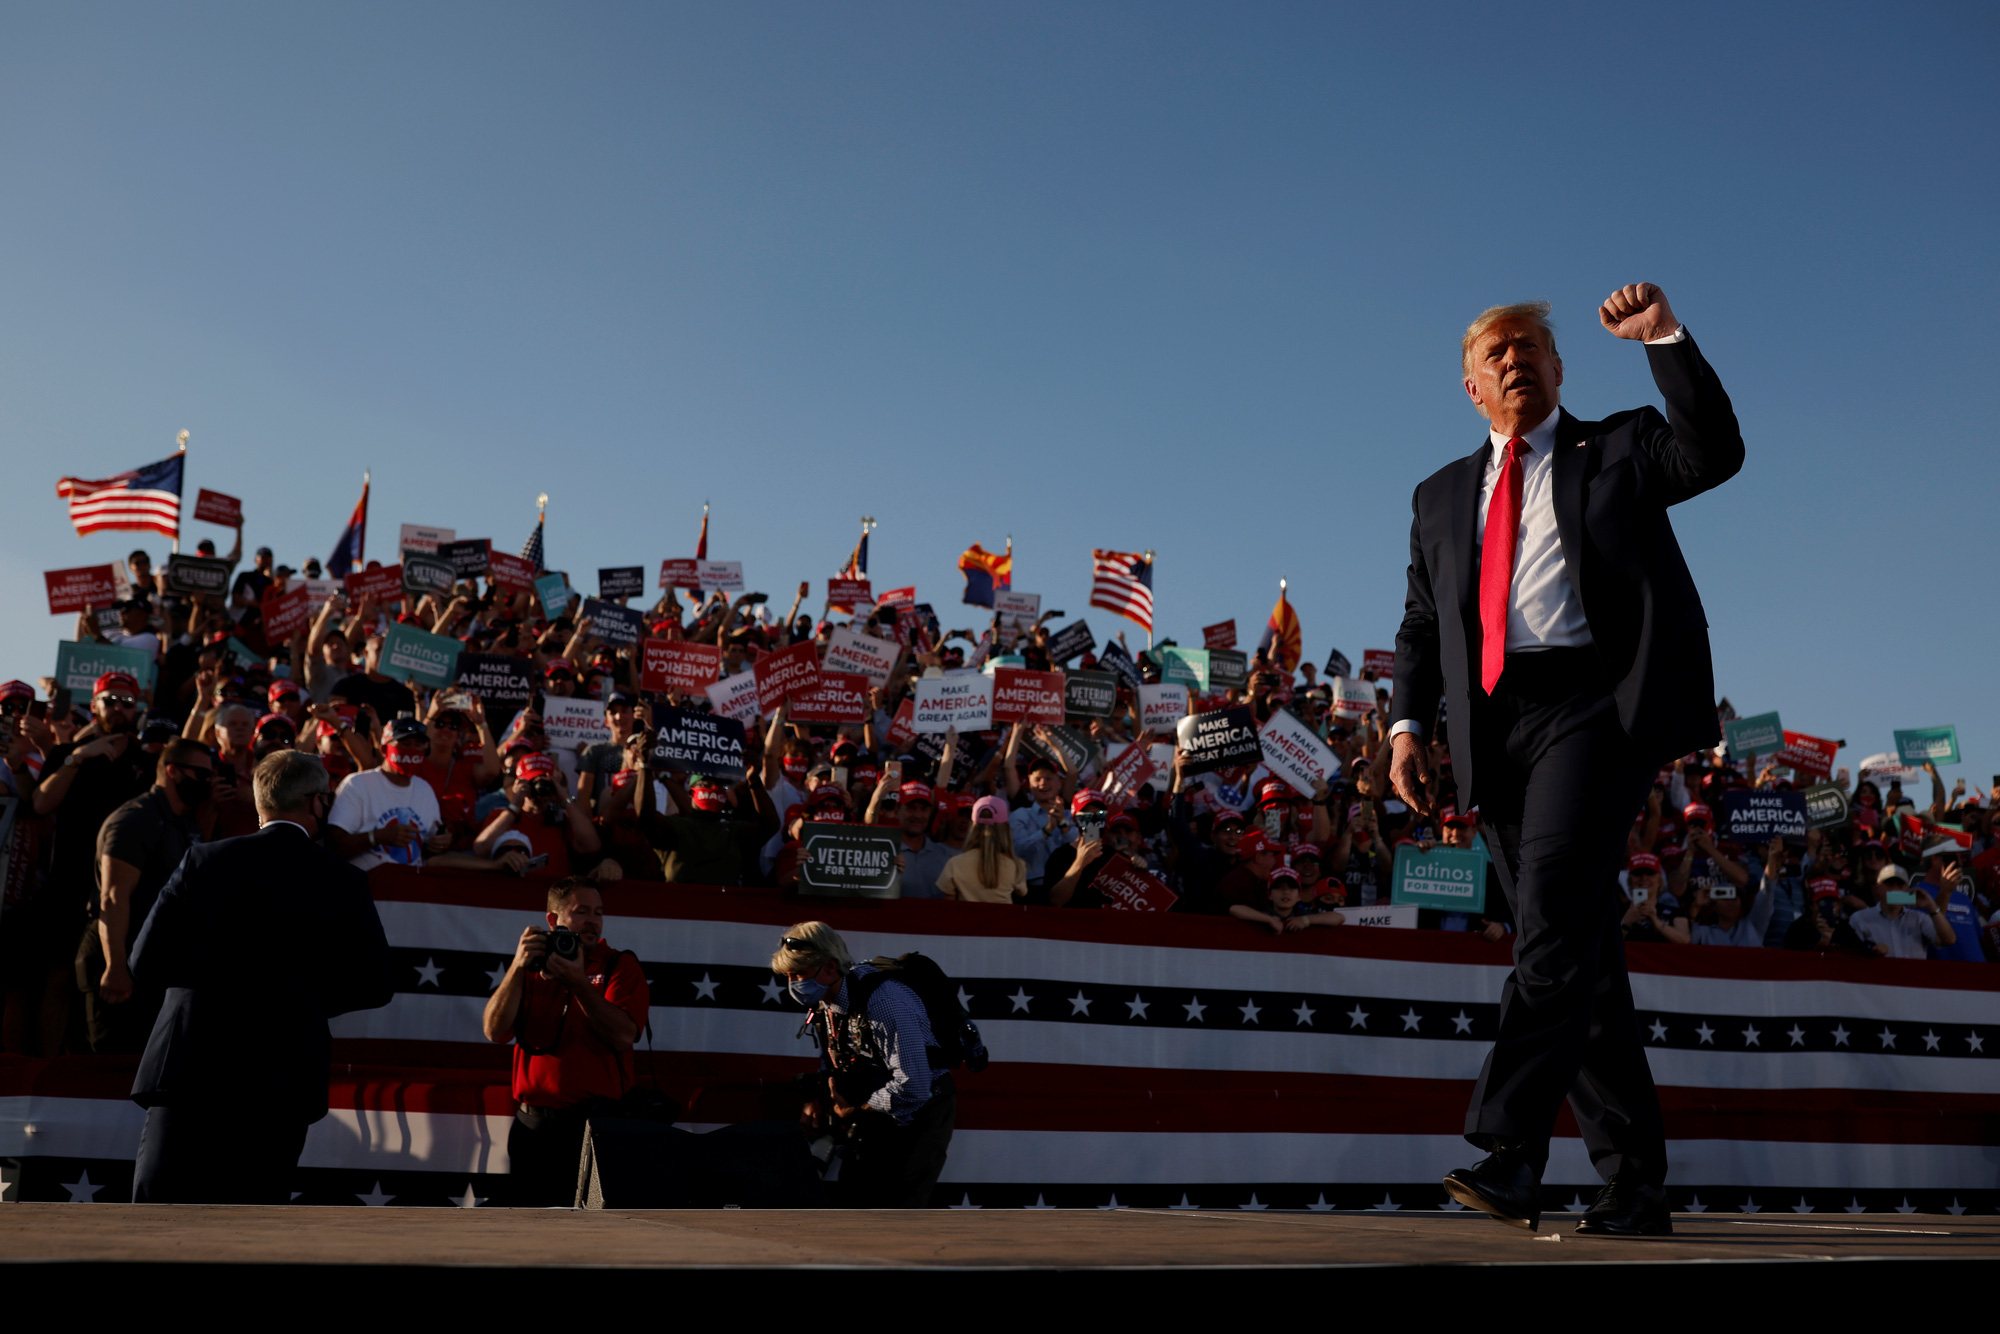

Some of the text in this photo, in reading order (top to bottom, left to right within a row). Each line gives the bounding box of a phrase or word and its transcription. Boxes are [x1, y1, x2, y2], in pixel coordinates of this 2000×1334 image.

[66, 573, 93, 582] MAKE
[177, 566, 225, 582] VETERANS
[490, 562, 532, 580] AMERICA
[51, 580, 113, 597] AMERICA
[601, 577, 643, 587] AMERICA
[830, 588, 869, 596] AMERICA
[601, 608, 625, 620] MAKE
[997, 603, 1035, 613] AMERICA
[395, 637, 450, 665] Latinos
[852, 640, 879, 654] MAKE
[1051, 631, 1090, 655] AMERICA
[647, 648, 718, 665] GREAT AGAIN
[769, 653, 796, 672] MAKE
[831, 645, 890, 670] AMERICA
[69, 655, 139, 677] Latinos
[393, 656, 445, 674] FOR TRUMP
[479, 662, 512, 674] MAKE
[647, 659, 716, 680] AMERICA
[828, 657, 859, 673] GREAT
[458, 672, 530, 689] AMERICA
[664, 675, 695, 688] MAKE
[760, 660, 817, 693] AMERICA
[823, 679, 846, 689] AKE
[1014, 677, 1043, 689] MAKE
[495, 689, 530, 700] AGAIN
[730, 680, 755, 694] MAKE
[760, 674, 819, 706] GREAT AGAIN
[941, 684, 970, 695] MAKE
[919, 695, 988, 711] AMERICA
[995, 687, 1061, 704] AMERICA
[1075, 699, 1090, 707] FOR
[565, 706, 594, 717] MAKE
[793, 701, 864, 715] GREAT AGAIN
[994, 701, 1062, 716] GREAT AGAIN
[544, 716, 611, 731] AMERICA
[681, 716, 718, 733] MAKE
[917, 710, 988, 723] GREAT AGAIN
[1144, 716, 1175, 725] GREAT
[1198, 717, 1230, 734] MAKE
[1733, 725, 1775, 741] Latinos
[577, 732, 610, 741] AGAIN
[657, 726, 743, 753] AMERICA
[1184, 725, 1254, 752] AMERICA
[1291, 731, 1318, 756] MAKE
[1903, 738, 1950, 750] Latinos
[654, 745, 744, 768] GREAT AGAIN
[1193, 741, 1258, 763] REAT AGAIN
[1266, 729, 1325, 777] AMERICA
[1259, 739, 1314, 785] GREAT AGAI
[1750, 797, 1783, 808] MAKE
[1730, 808, 1805, 824] AMERICA
[1731, 823, 1806, 837] GREAT AGAIN
[817, 847, 890, 868] VETERANS
[824, 865, 882, 877] FOR TRUMP
[1405, 859, 1474, 882] Latinos
[1121, 870, 1151, 894] MAKE
[1407, 882, 1471, 894] FOR TRUMP
[1359, 915, 1392, 927] MAKE
